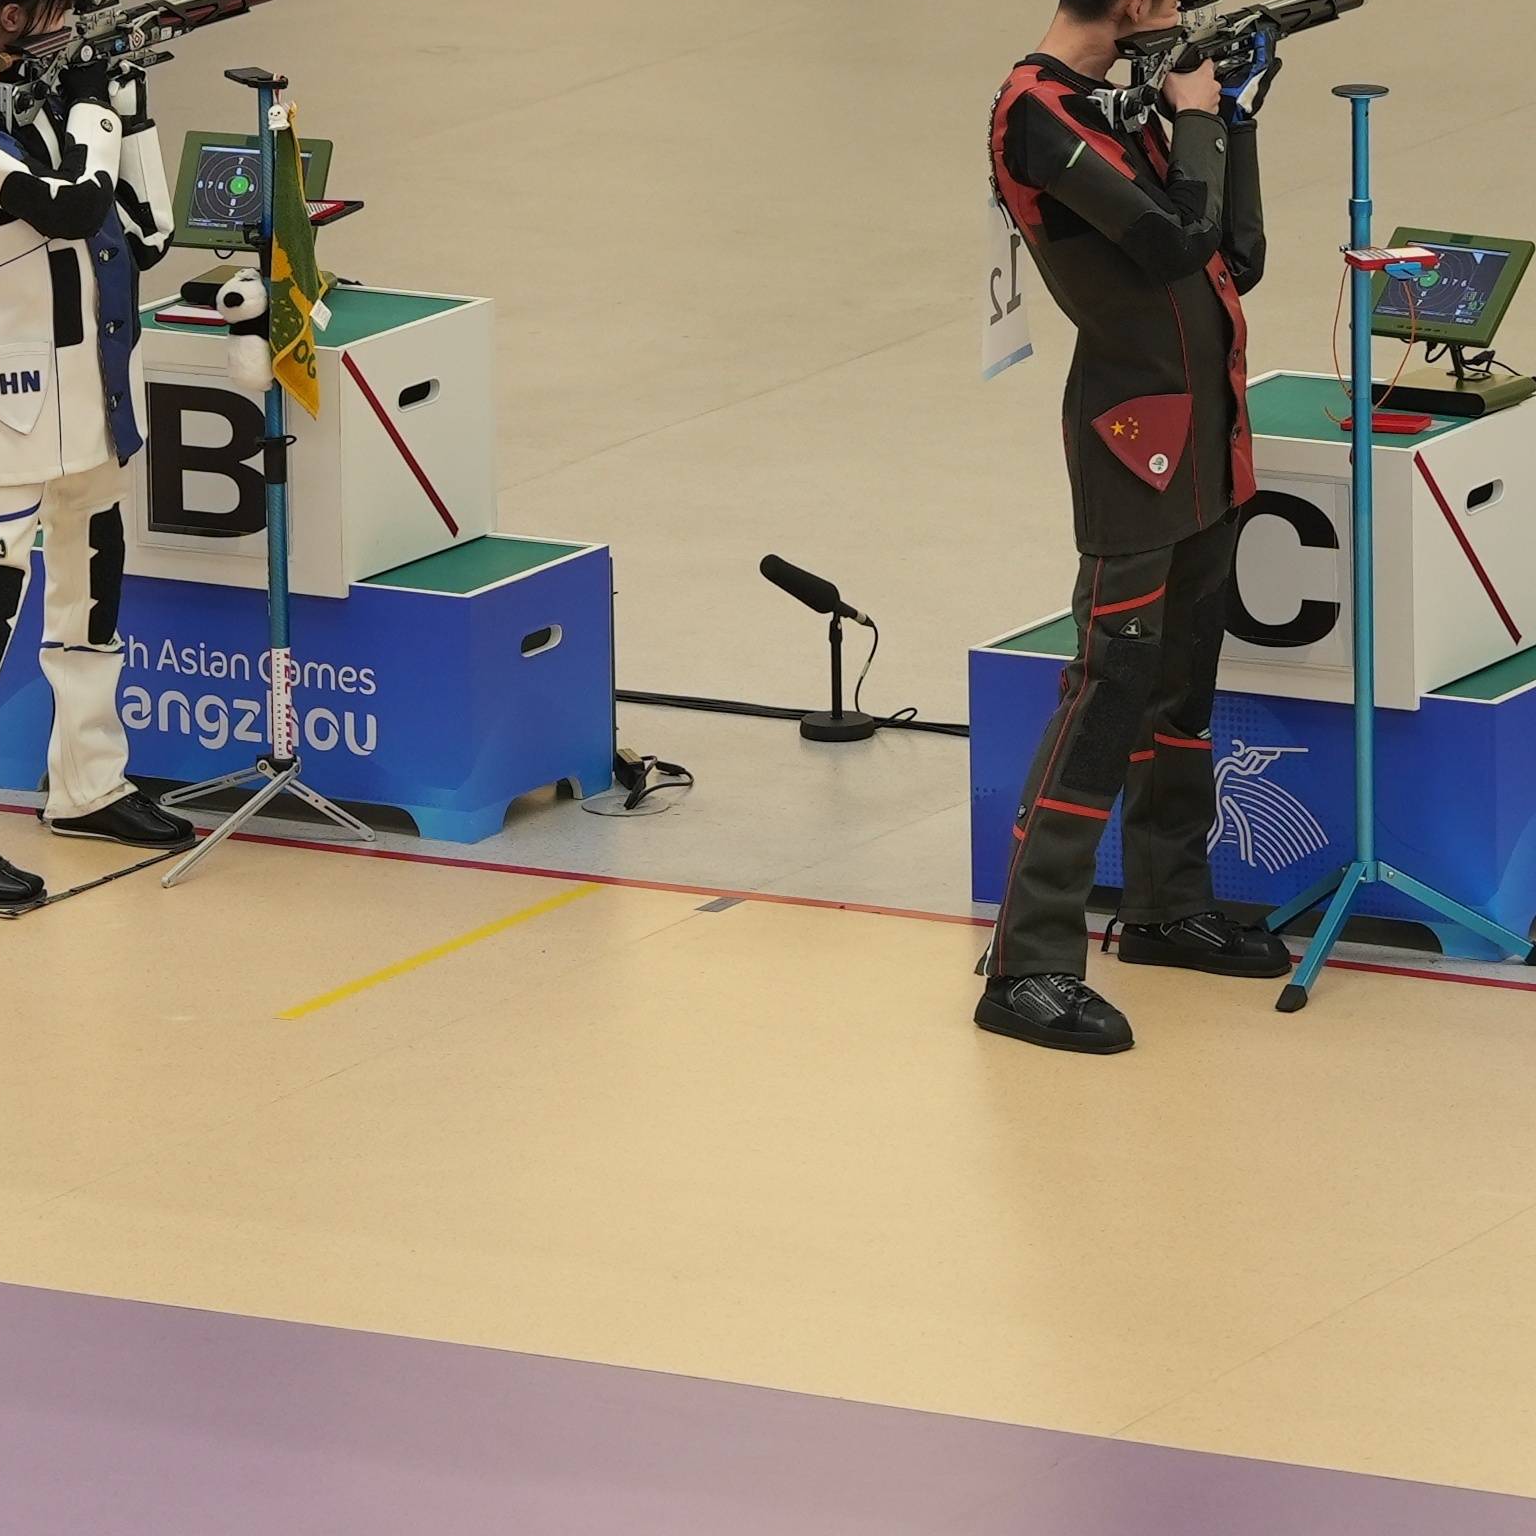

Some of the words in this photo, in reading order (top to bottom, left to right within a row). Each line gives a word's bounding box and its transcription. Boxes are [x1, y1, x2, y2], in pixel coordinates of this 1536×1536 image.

[145, 382, 267, 538] B
[1222, 490, 1341, 647] C
[156, 639, 250, 681] Asian
